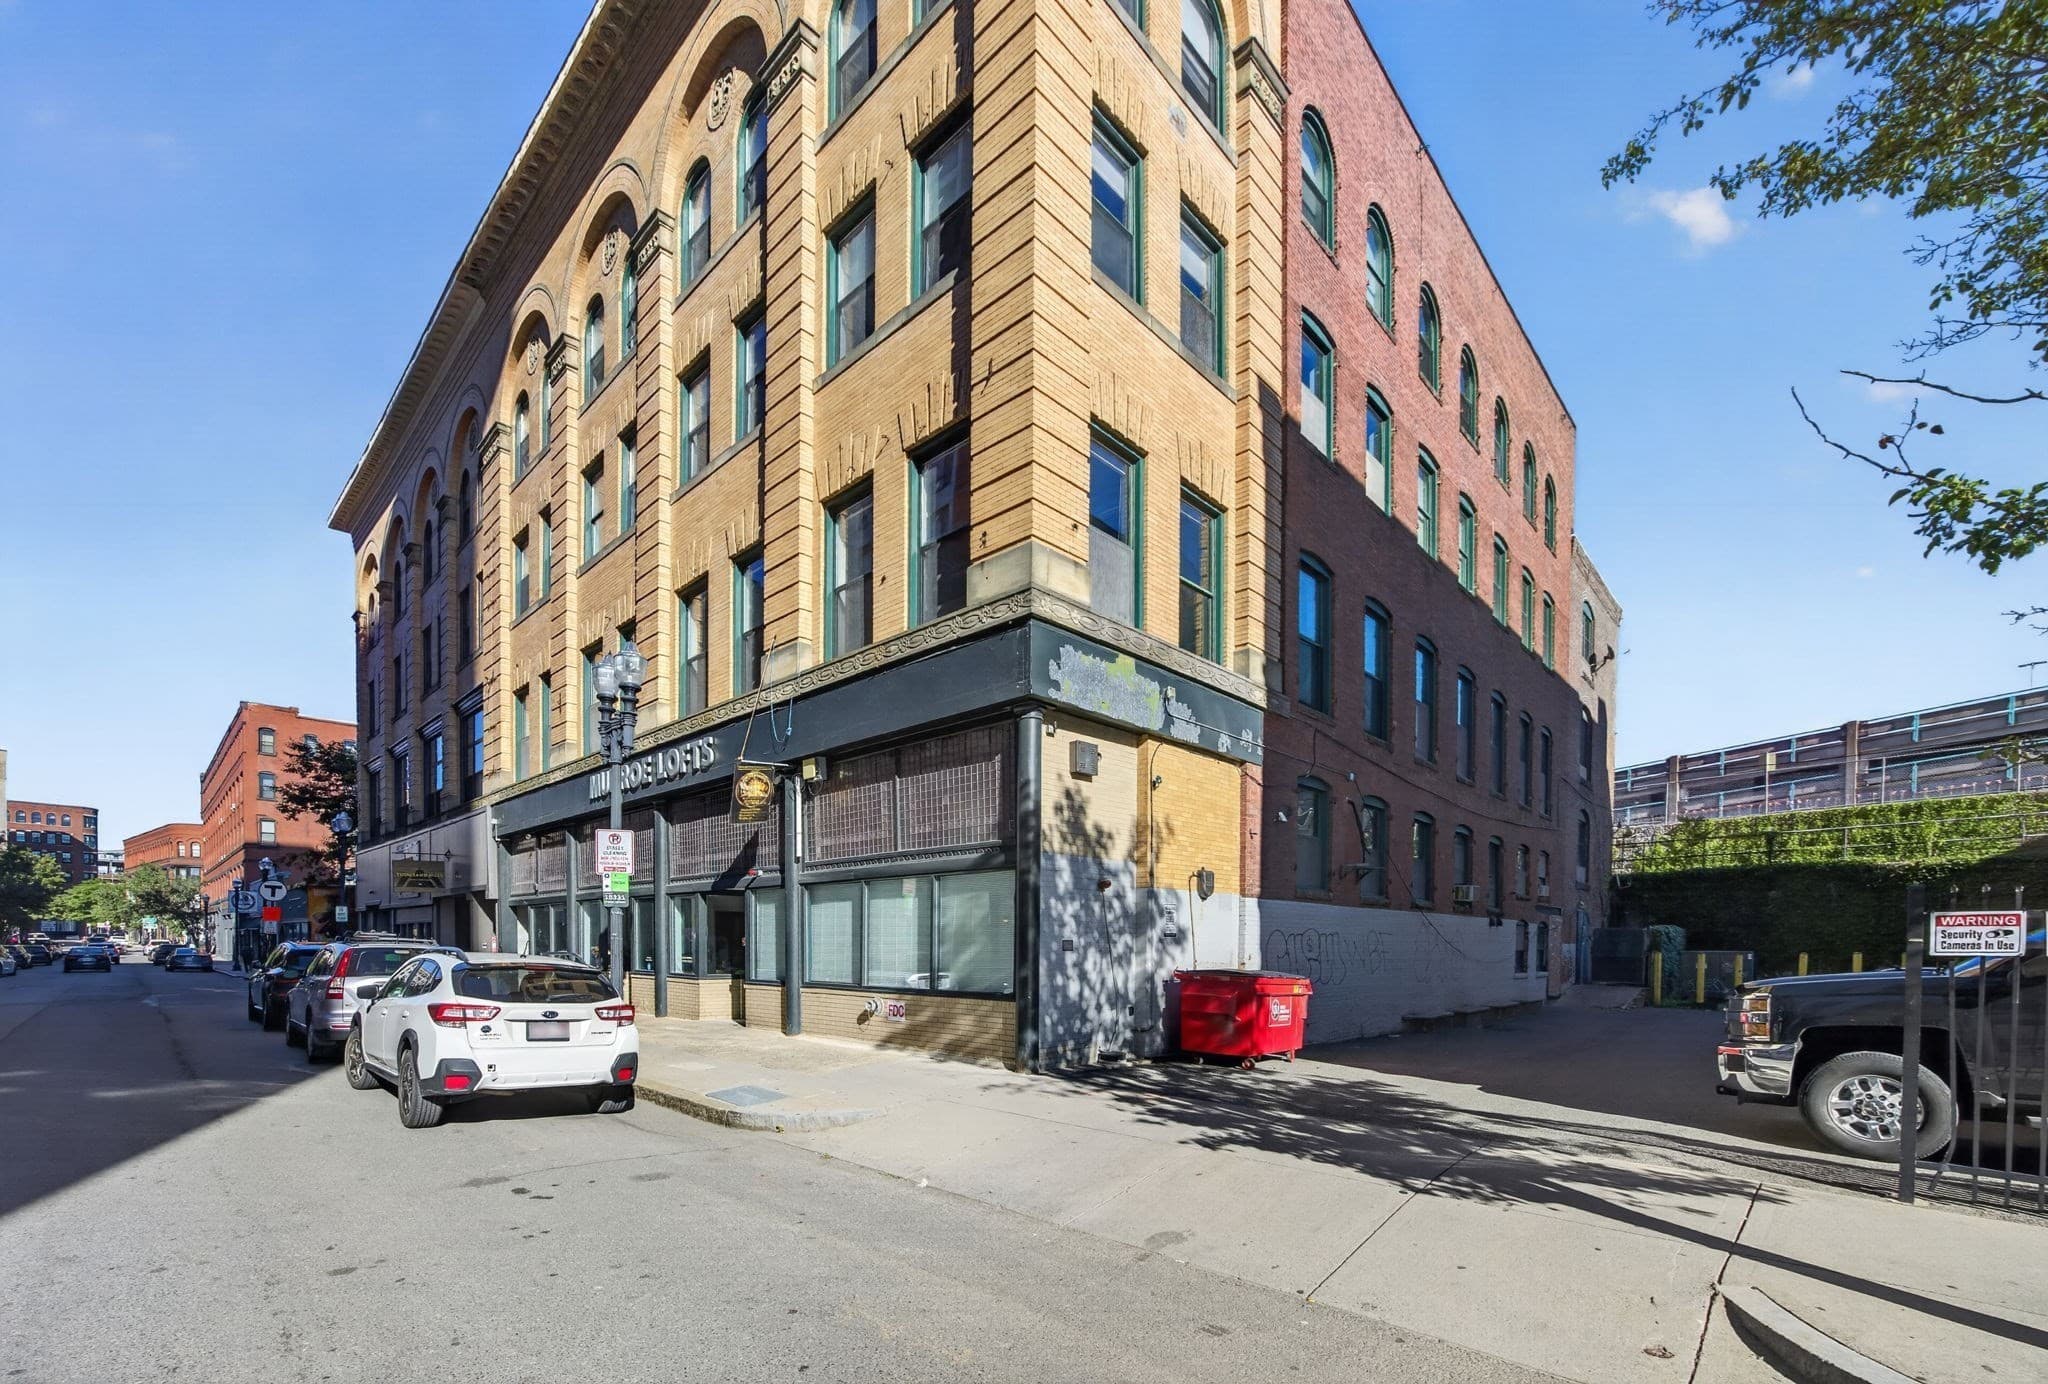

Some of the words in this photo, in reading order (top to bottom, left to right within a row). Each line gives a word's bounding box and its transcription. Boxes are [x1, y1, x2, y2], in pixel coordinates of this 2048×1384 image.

[589, 755, 652, 799] MUROE
[656, 736, 715, 780] LOFTS
[264, 885, 283, 898] T
[1940, 915, 2017, 926] WARNING
[1940, 929, 1983, 941] Security
[1940, 941, 1982, 950] Cameras
[1985, 940, 1994, 950] In
[1997, 940, 2015, 950] Use
[888, 1004, 905, 1018] FDC
